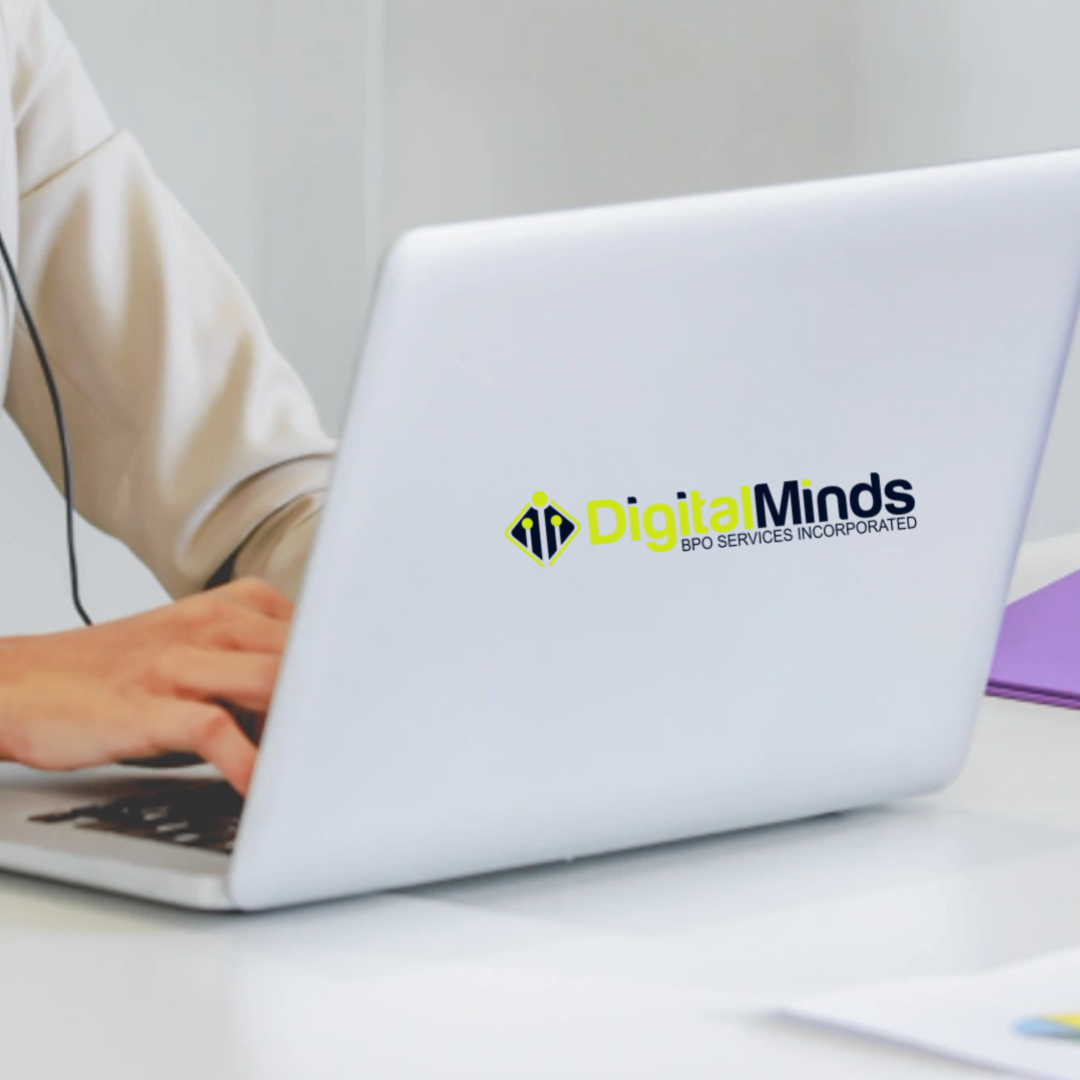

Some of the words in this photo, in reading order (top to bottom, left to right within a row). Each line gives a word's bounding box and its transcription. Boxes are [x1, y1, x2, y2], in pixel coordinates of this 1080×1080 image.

[586, 472, 916, 553] DigitalMinds
[681, 536, 713, 552] BPO
[718, 528, 793, 549] SERVICES
[797, 516, 917, 541] INCORPORATED
